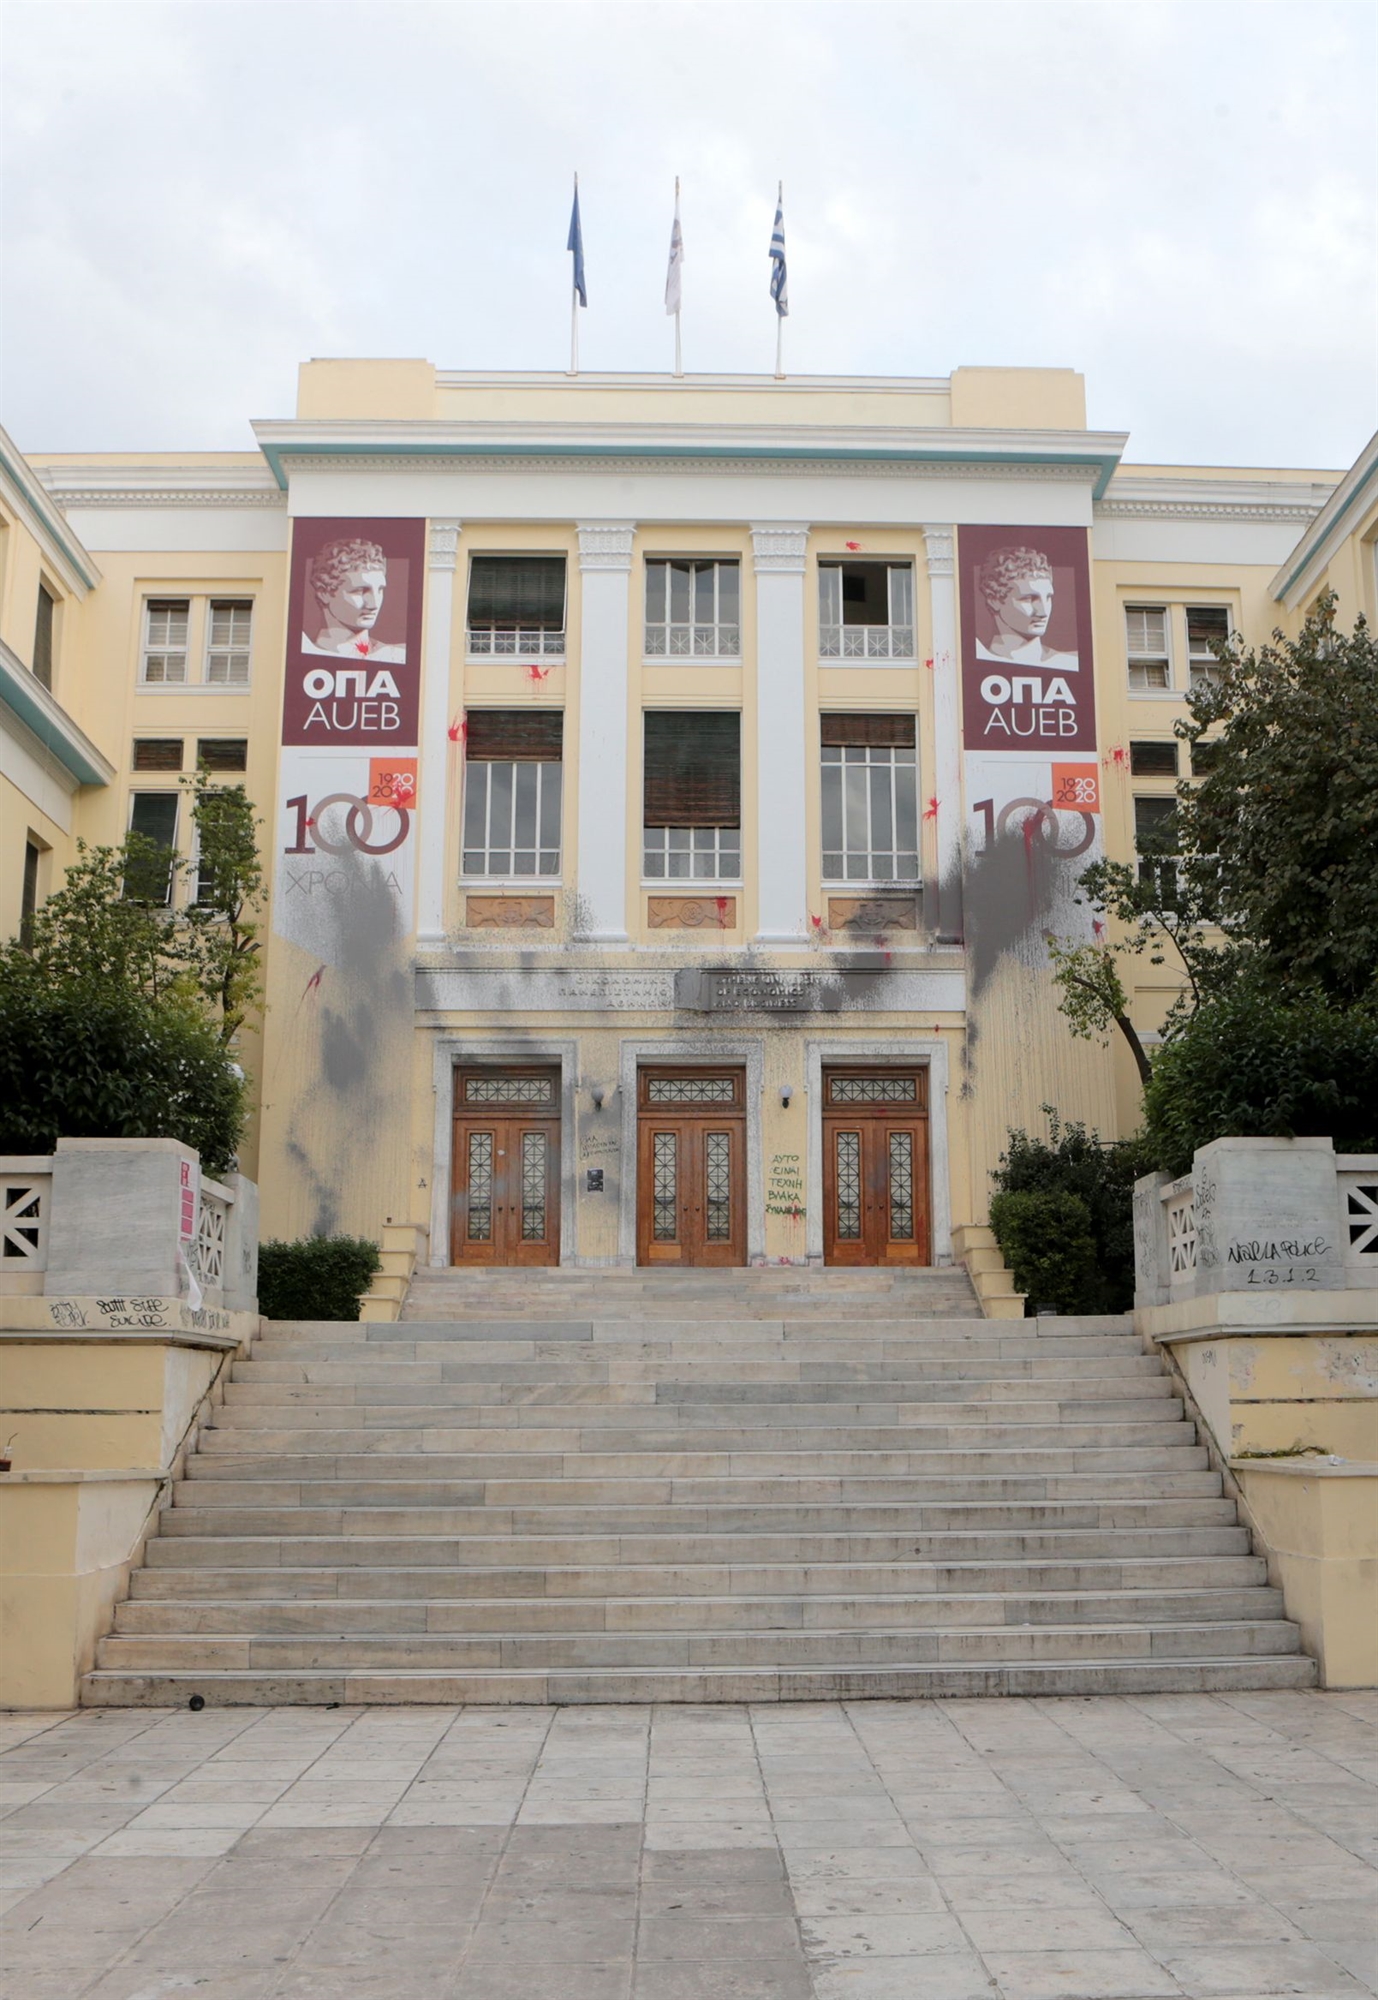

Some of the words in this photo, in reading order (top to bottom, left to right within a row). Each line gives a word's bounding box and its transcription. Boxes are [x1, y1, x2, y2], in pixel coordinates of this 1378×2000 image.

[302, 668, 401, 699] ΟΠΑ
[980, 675, 1076, 705] ΟΠΑ
[303, 701, 400, 731] AUEB
[984, 707, 1078, 737] AUEB
[378, 773, 414, 786] 1920
[1061, 777, 1096, 791] 1920
[1056, 790, 1097, 803] 2020
[284, 792, 410, 855] 100
